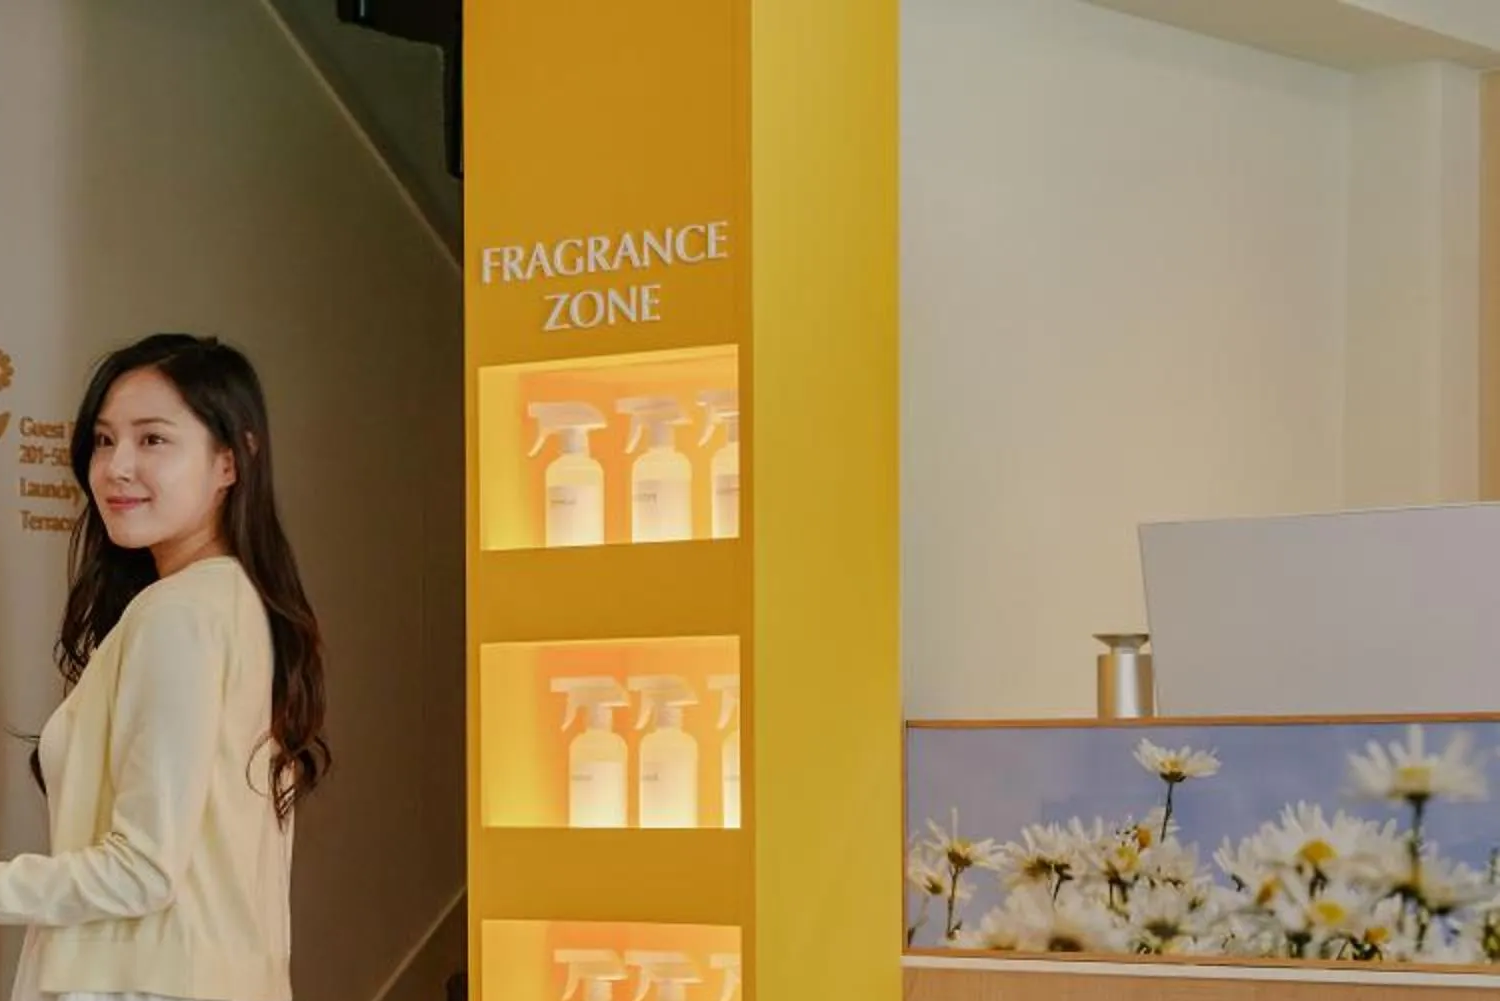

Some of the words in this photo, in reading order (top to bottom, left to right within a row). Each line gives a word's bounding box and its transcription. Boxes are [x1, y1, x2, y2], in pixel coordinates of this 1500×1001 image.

[482, 221, 728, 284] FRAGRANCE
[543, 284, 661, 331] ZONE
[19, 416, 66, 439] Guest
[20, 477, 80, 507] Laundry
